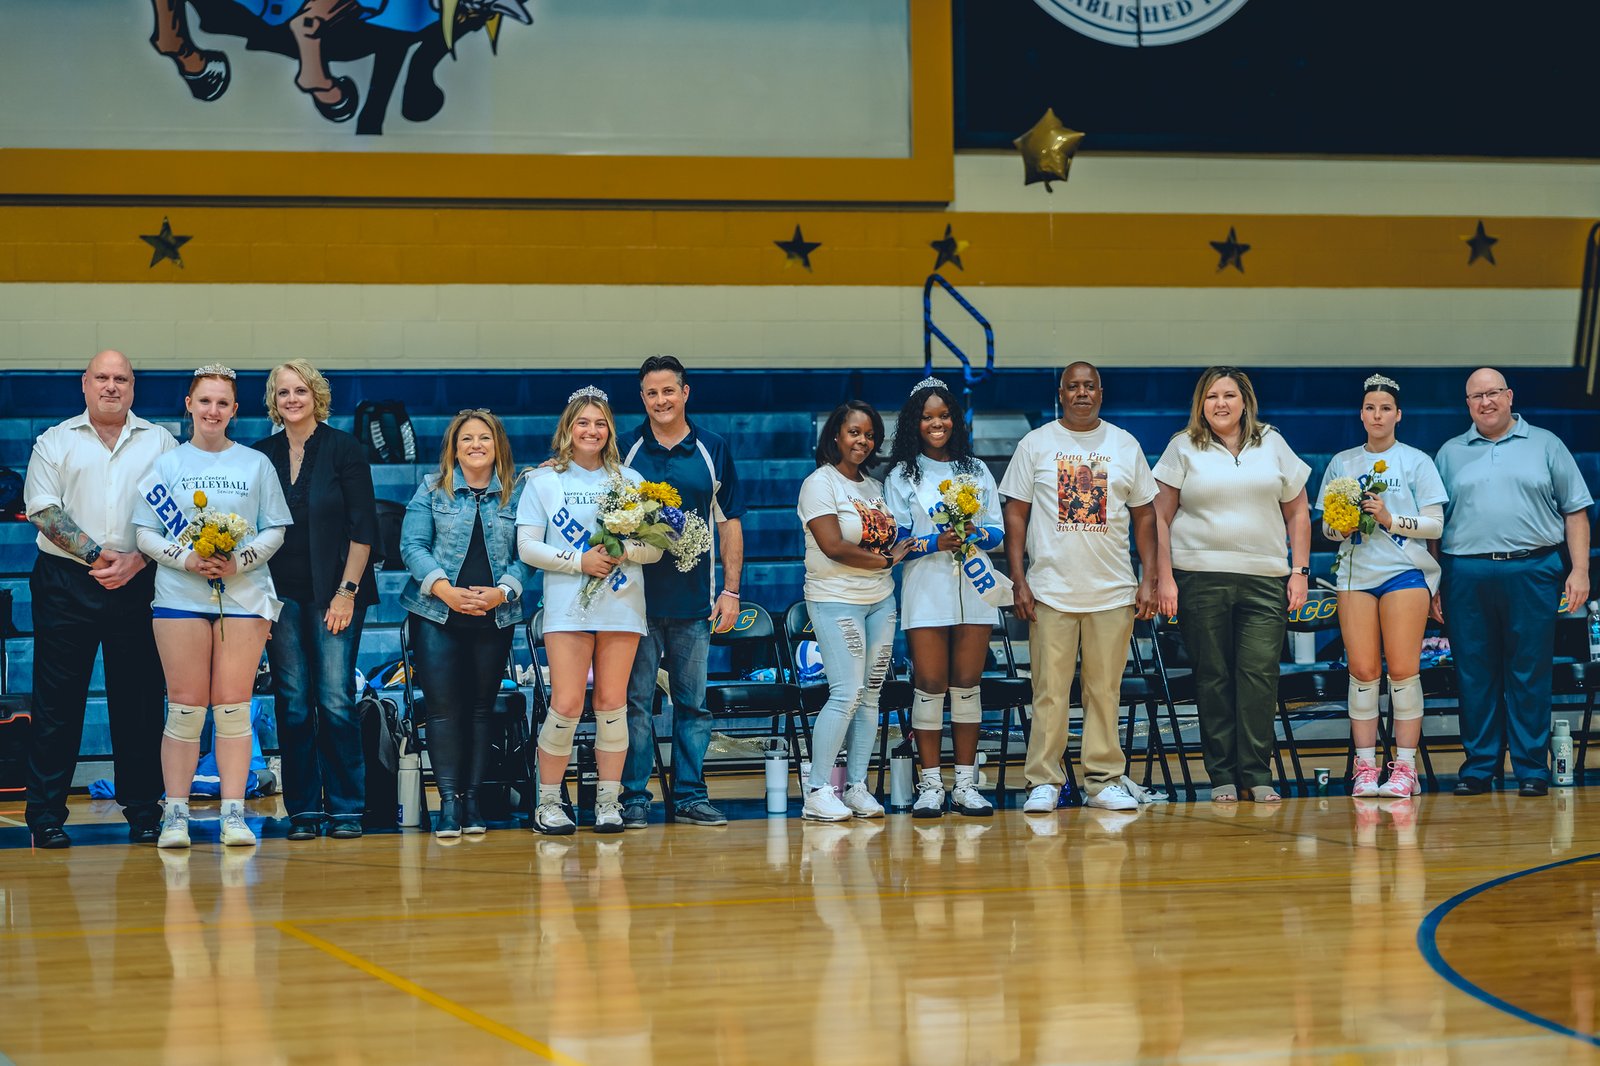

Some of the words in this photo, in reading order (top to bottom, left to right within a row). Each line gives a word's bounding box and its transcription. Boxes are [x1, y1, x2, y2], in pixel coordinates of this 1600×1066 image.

[1054, 452, 1083, 462] Long
[1087, 452, 1112, 462] Live
[182, 480, 249, 491] VOLLEYBALL
[146, 484, 190, 538] SEN
[1057, 523, 1079, 533] First
[1082, 523, 1110, 536] Lady
